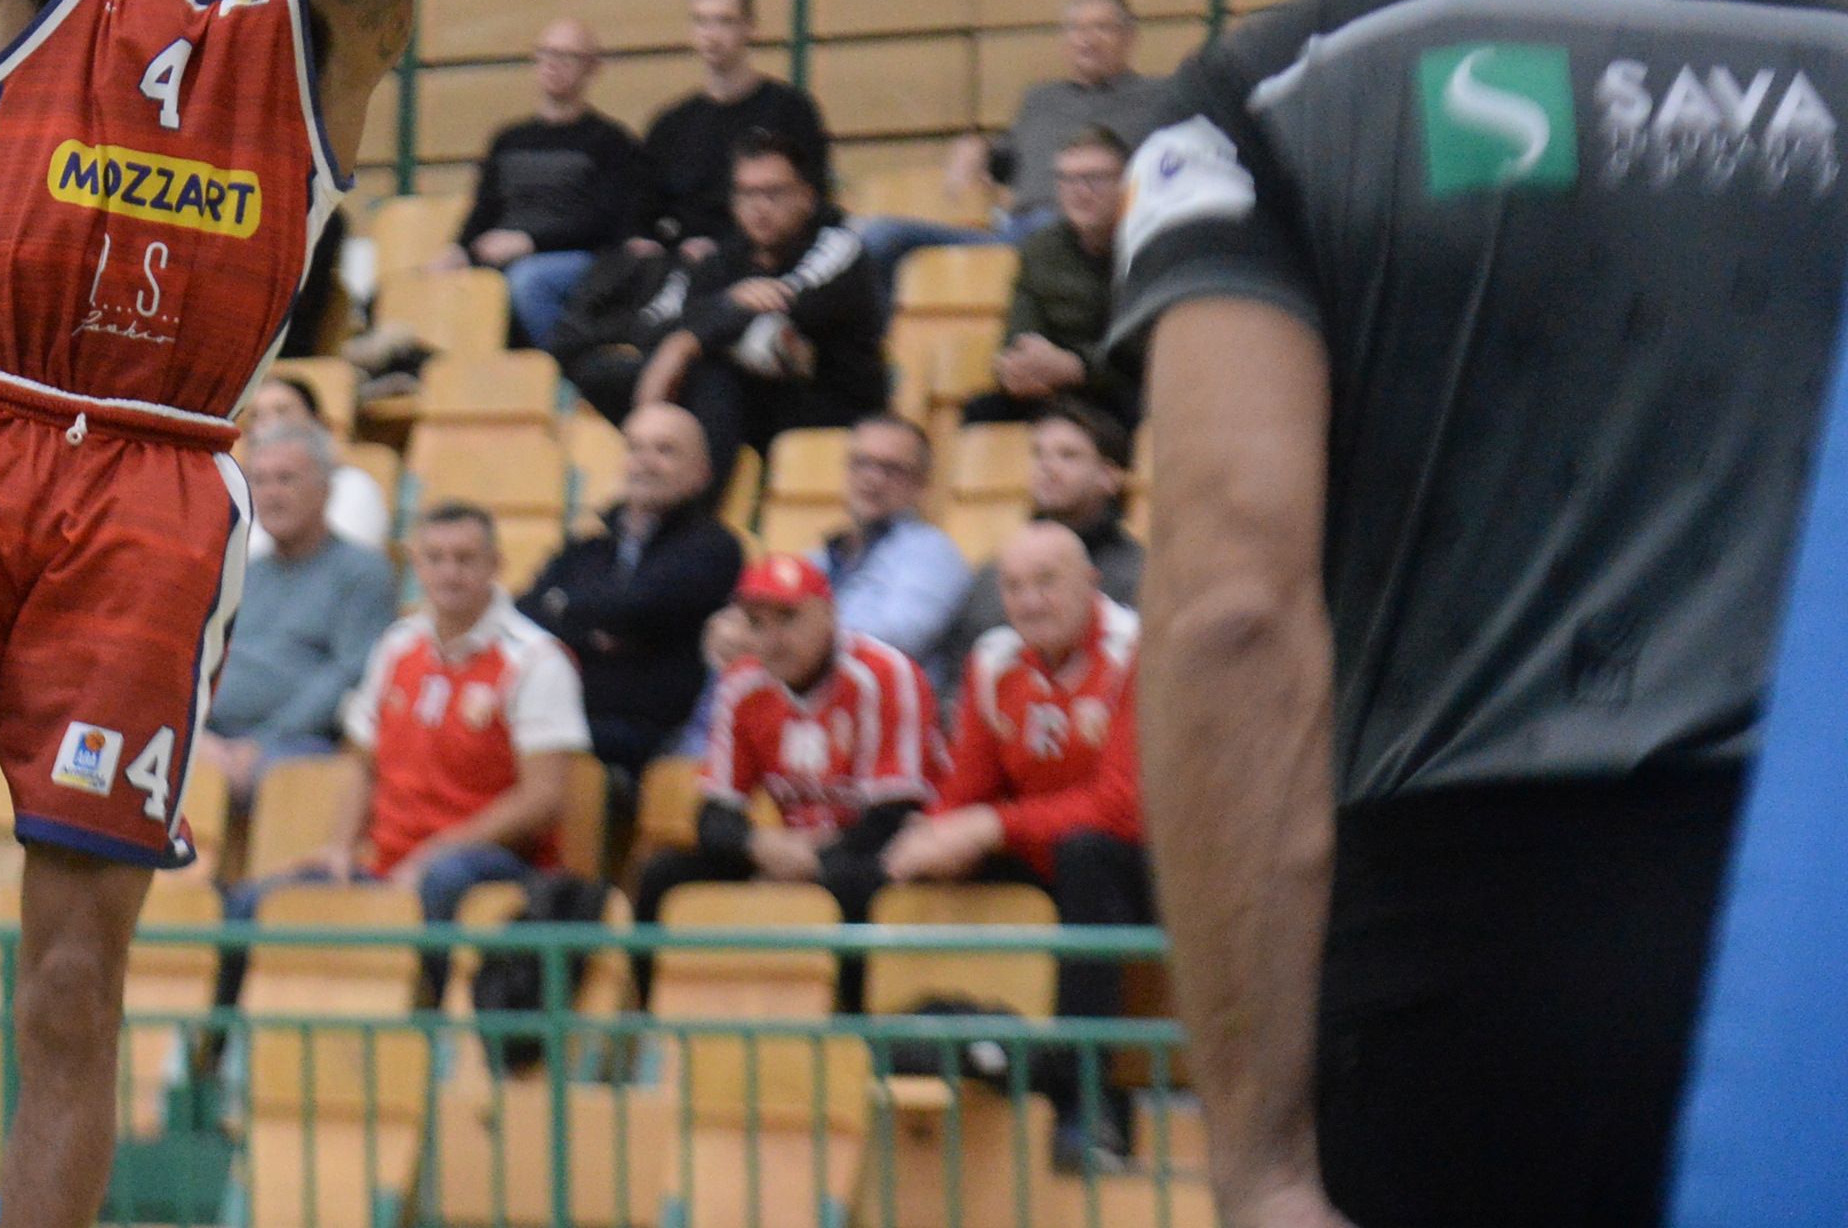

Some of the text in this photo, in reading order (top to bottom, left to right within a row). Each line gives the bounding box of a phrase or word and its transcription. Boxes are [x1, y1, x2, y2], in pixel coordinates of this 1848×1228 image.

[139, 36, 193, 131] 4
[1594, 59, 1837, 140] SAVA
[59, 151, 255, 225] MOZZART
[124, 724, 175, 821] 4
